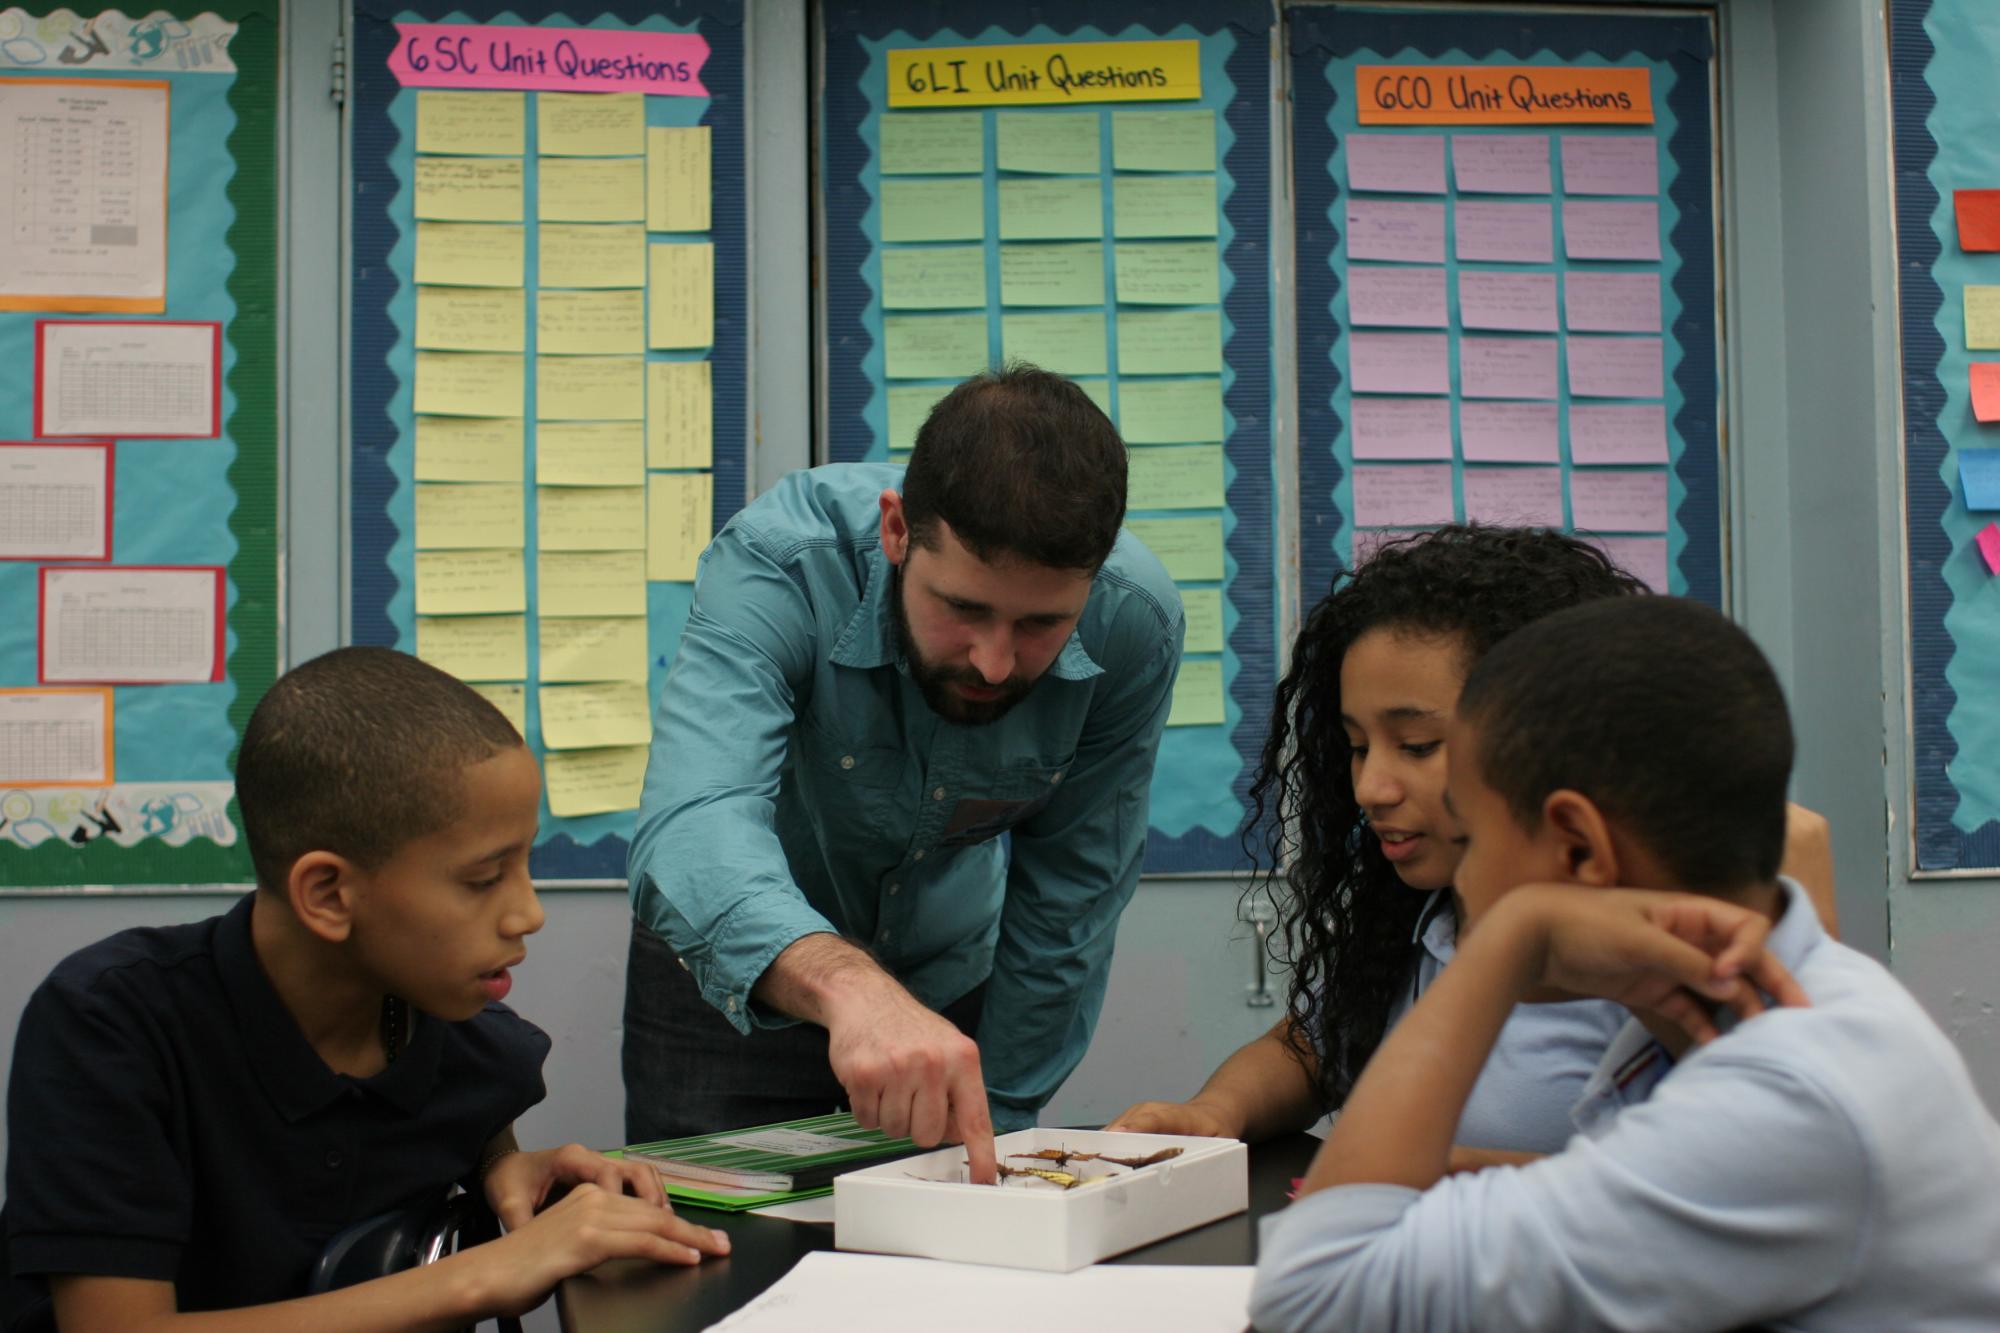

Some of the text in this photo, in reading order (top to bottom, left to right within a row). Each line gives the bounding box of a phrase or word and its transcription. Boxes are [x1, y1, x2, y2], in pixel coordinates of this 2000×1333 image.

[489, 41, 546, 75] Unit
[554, 39, 690, 82] Questions
[906, 53, 1167, 95] 6LI Unit Questions
[1374, 75, 1632, 113] 6CO Unit Questions
